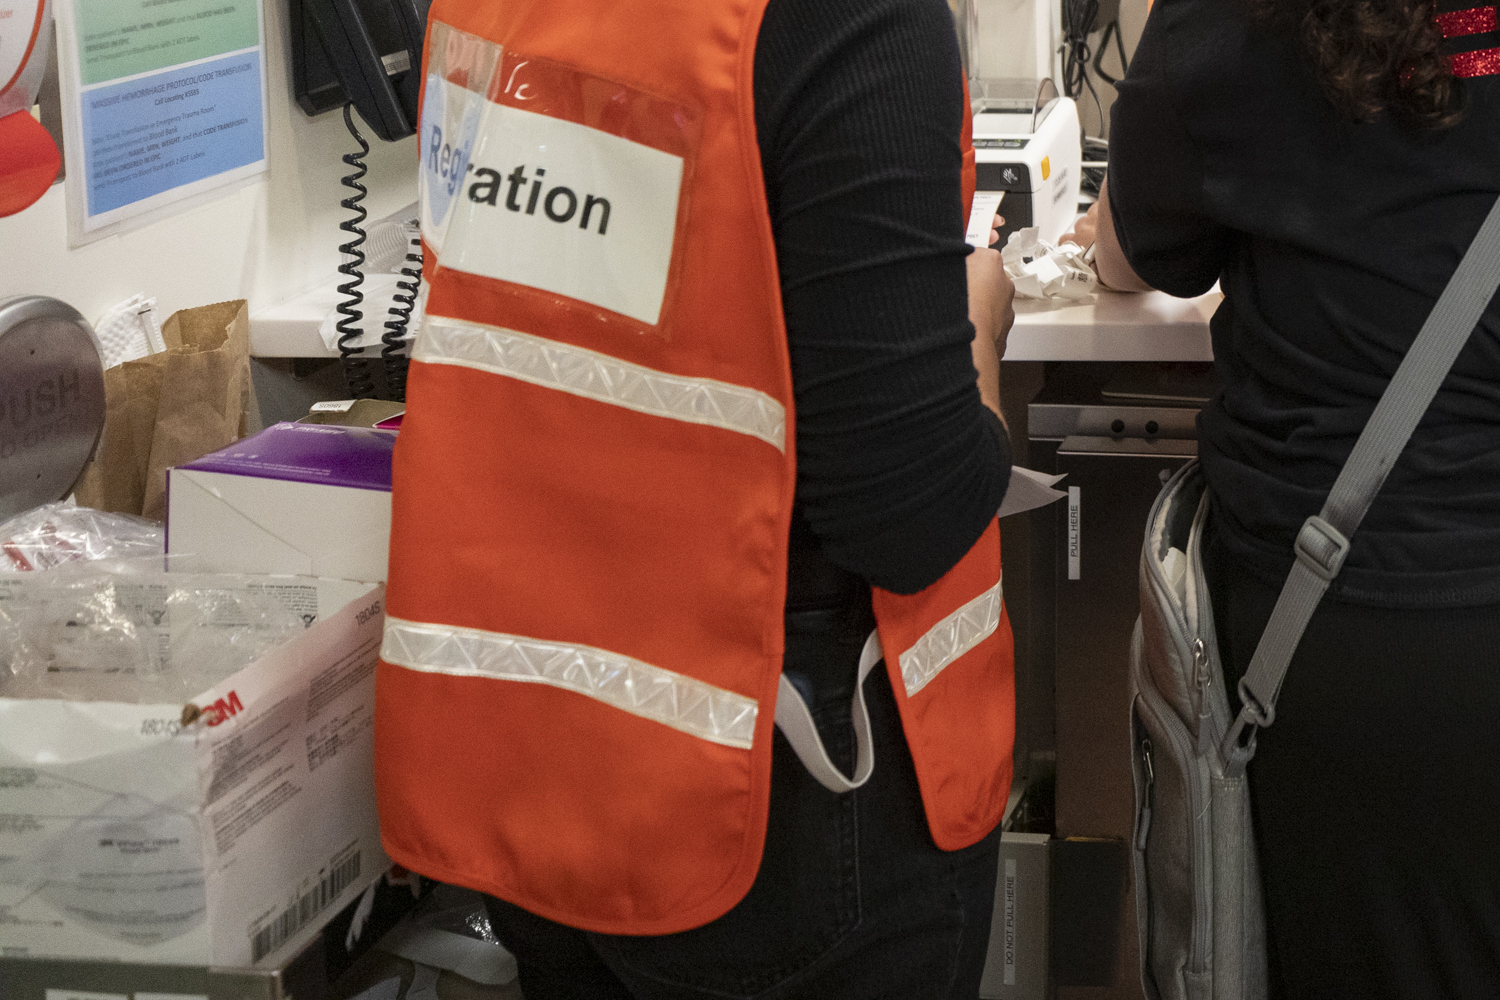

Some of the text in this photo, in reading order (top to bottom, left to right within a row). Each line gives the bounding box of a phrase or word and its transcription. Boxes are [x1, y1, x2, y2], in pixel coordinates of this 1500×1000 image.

[1070, 504, 1079, 558] PULL HERE
[355, 601, 381, 626] 1804S
[201, 689, 244, 728] 3M
[1005, 875, 1014, 965] DO NOT PULL HERE
